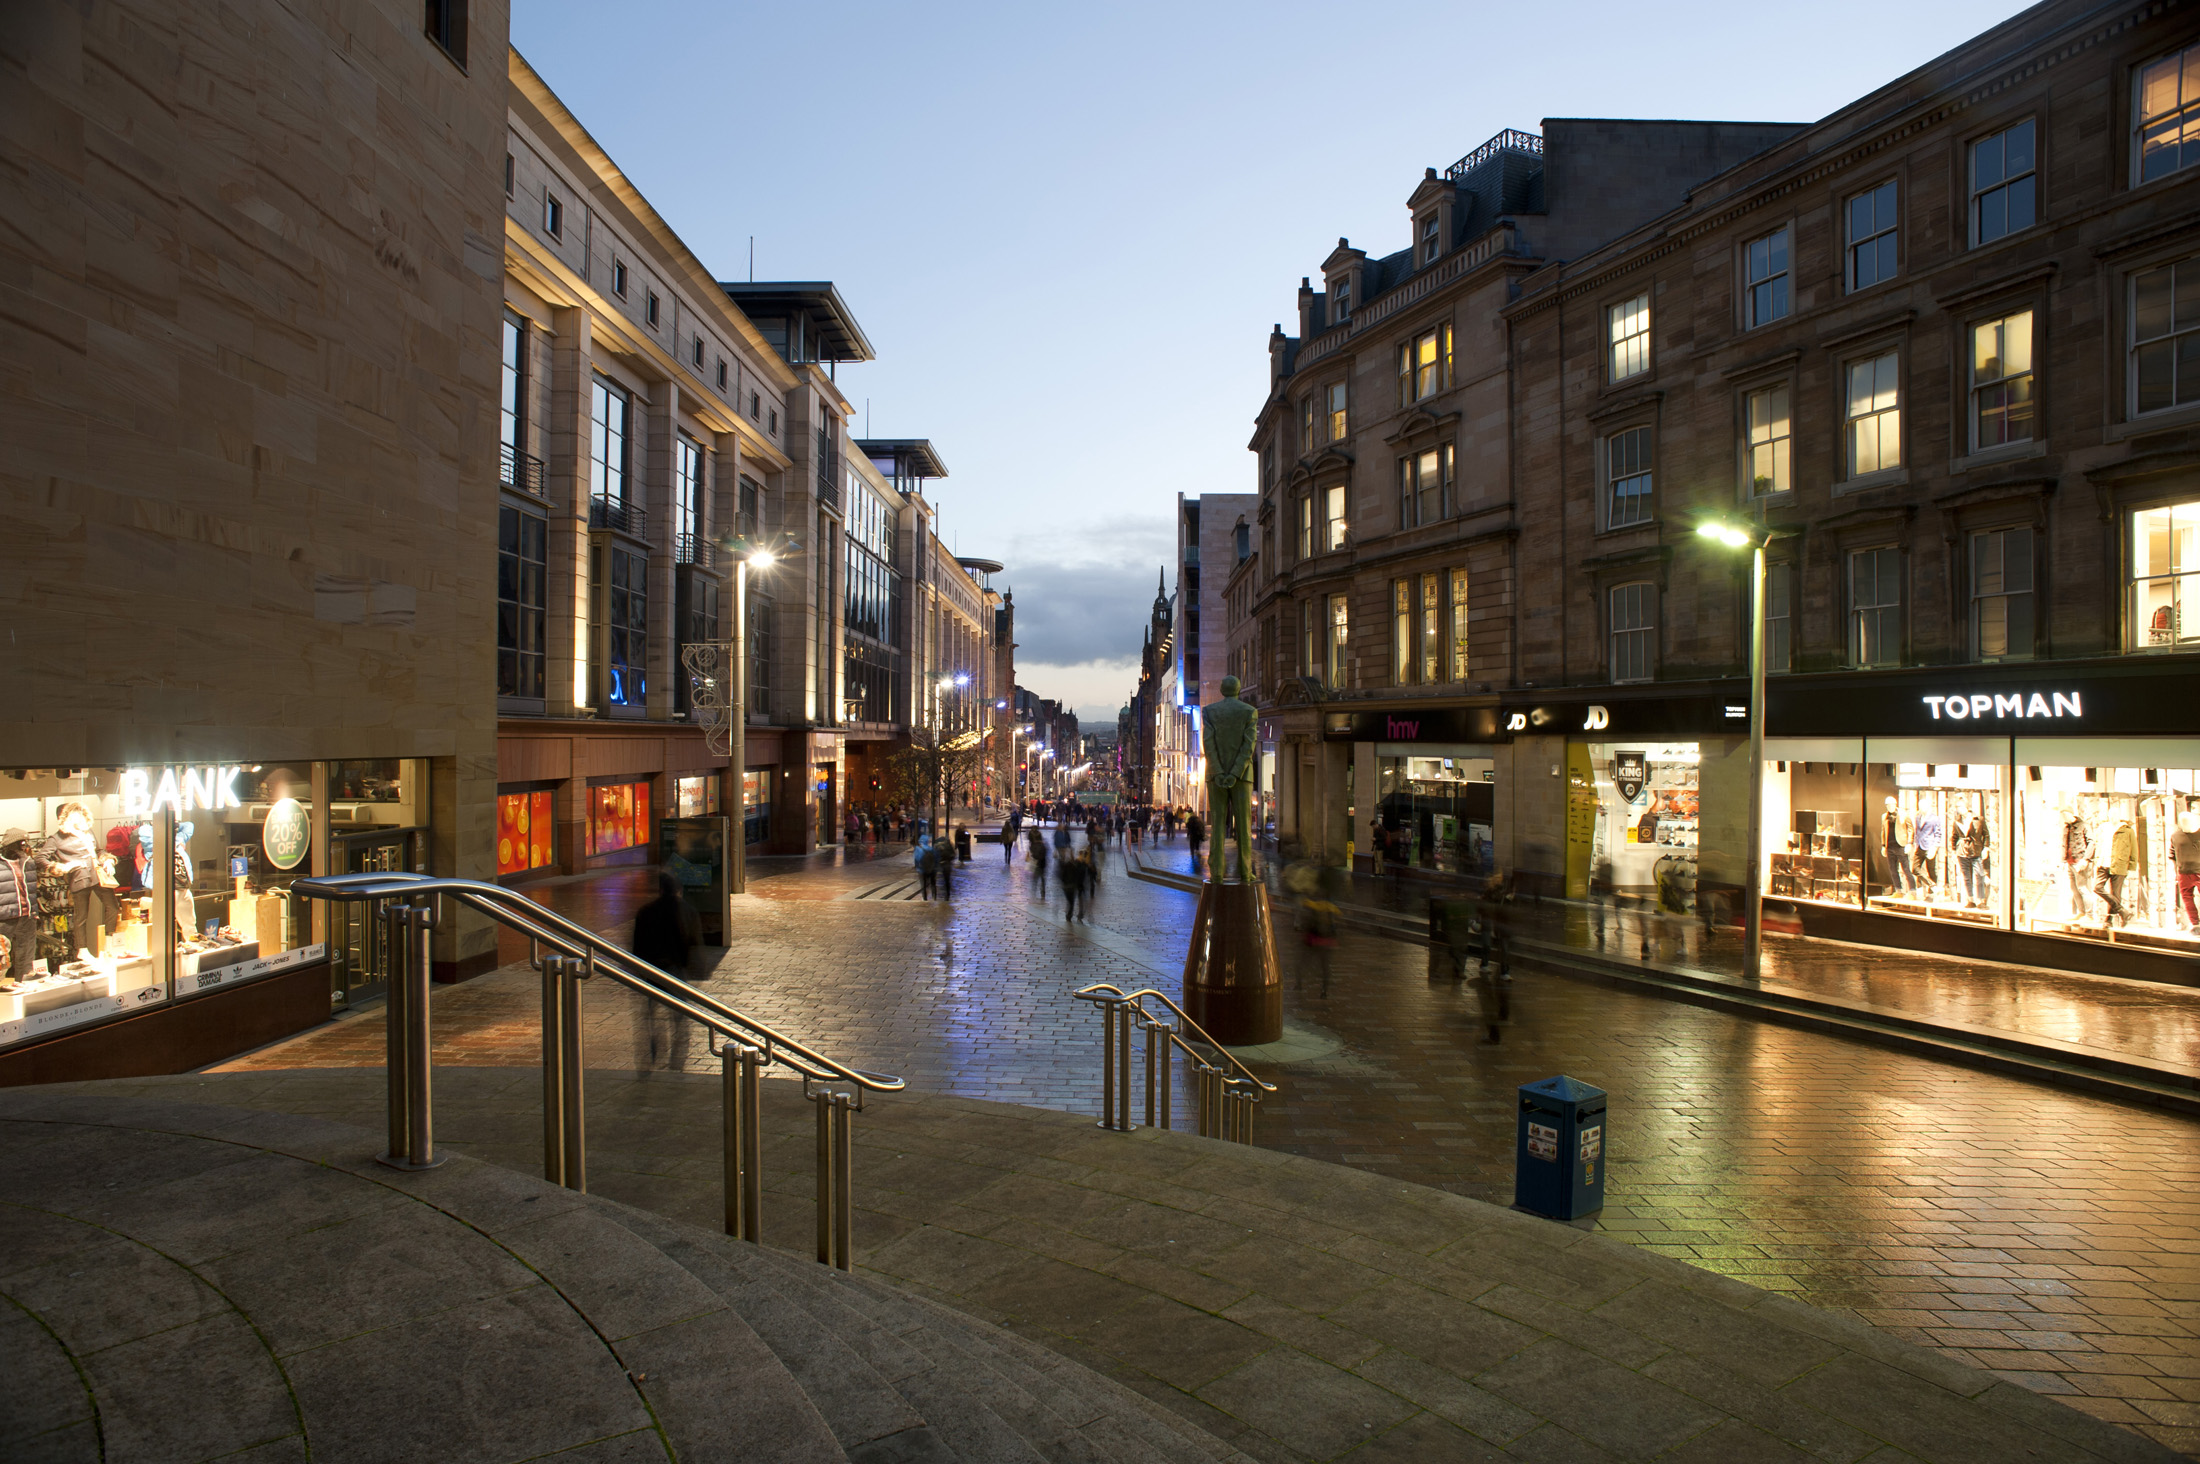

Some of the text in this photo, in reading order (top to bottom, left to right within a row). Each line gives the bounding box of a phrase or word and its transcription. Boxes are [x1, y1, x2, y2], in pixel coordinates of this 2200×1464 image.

[1922, 691, 2083, 720] TOPMAN
[1387, 714, 1420, 739] hmv
[1506, 713, 1527, 730] JD
[1583, 705, 1609, 730] JD
[1618, 767, 1643, 778] KING
[124, 766, 242, 815] BANK
[271, 821, 303, 843] 20%
[277, 841, 298, 855] OFF
[252, 955, 290, 971] JACK JONES
[197, 969, 223, 982] CRIMINAL
[198, 976, 222, 989] DAMAGE
[38, 1012, 70, 1024] BLONDE
[74, 1003, 103, 1015] BLONDE
